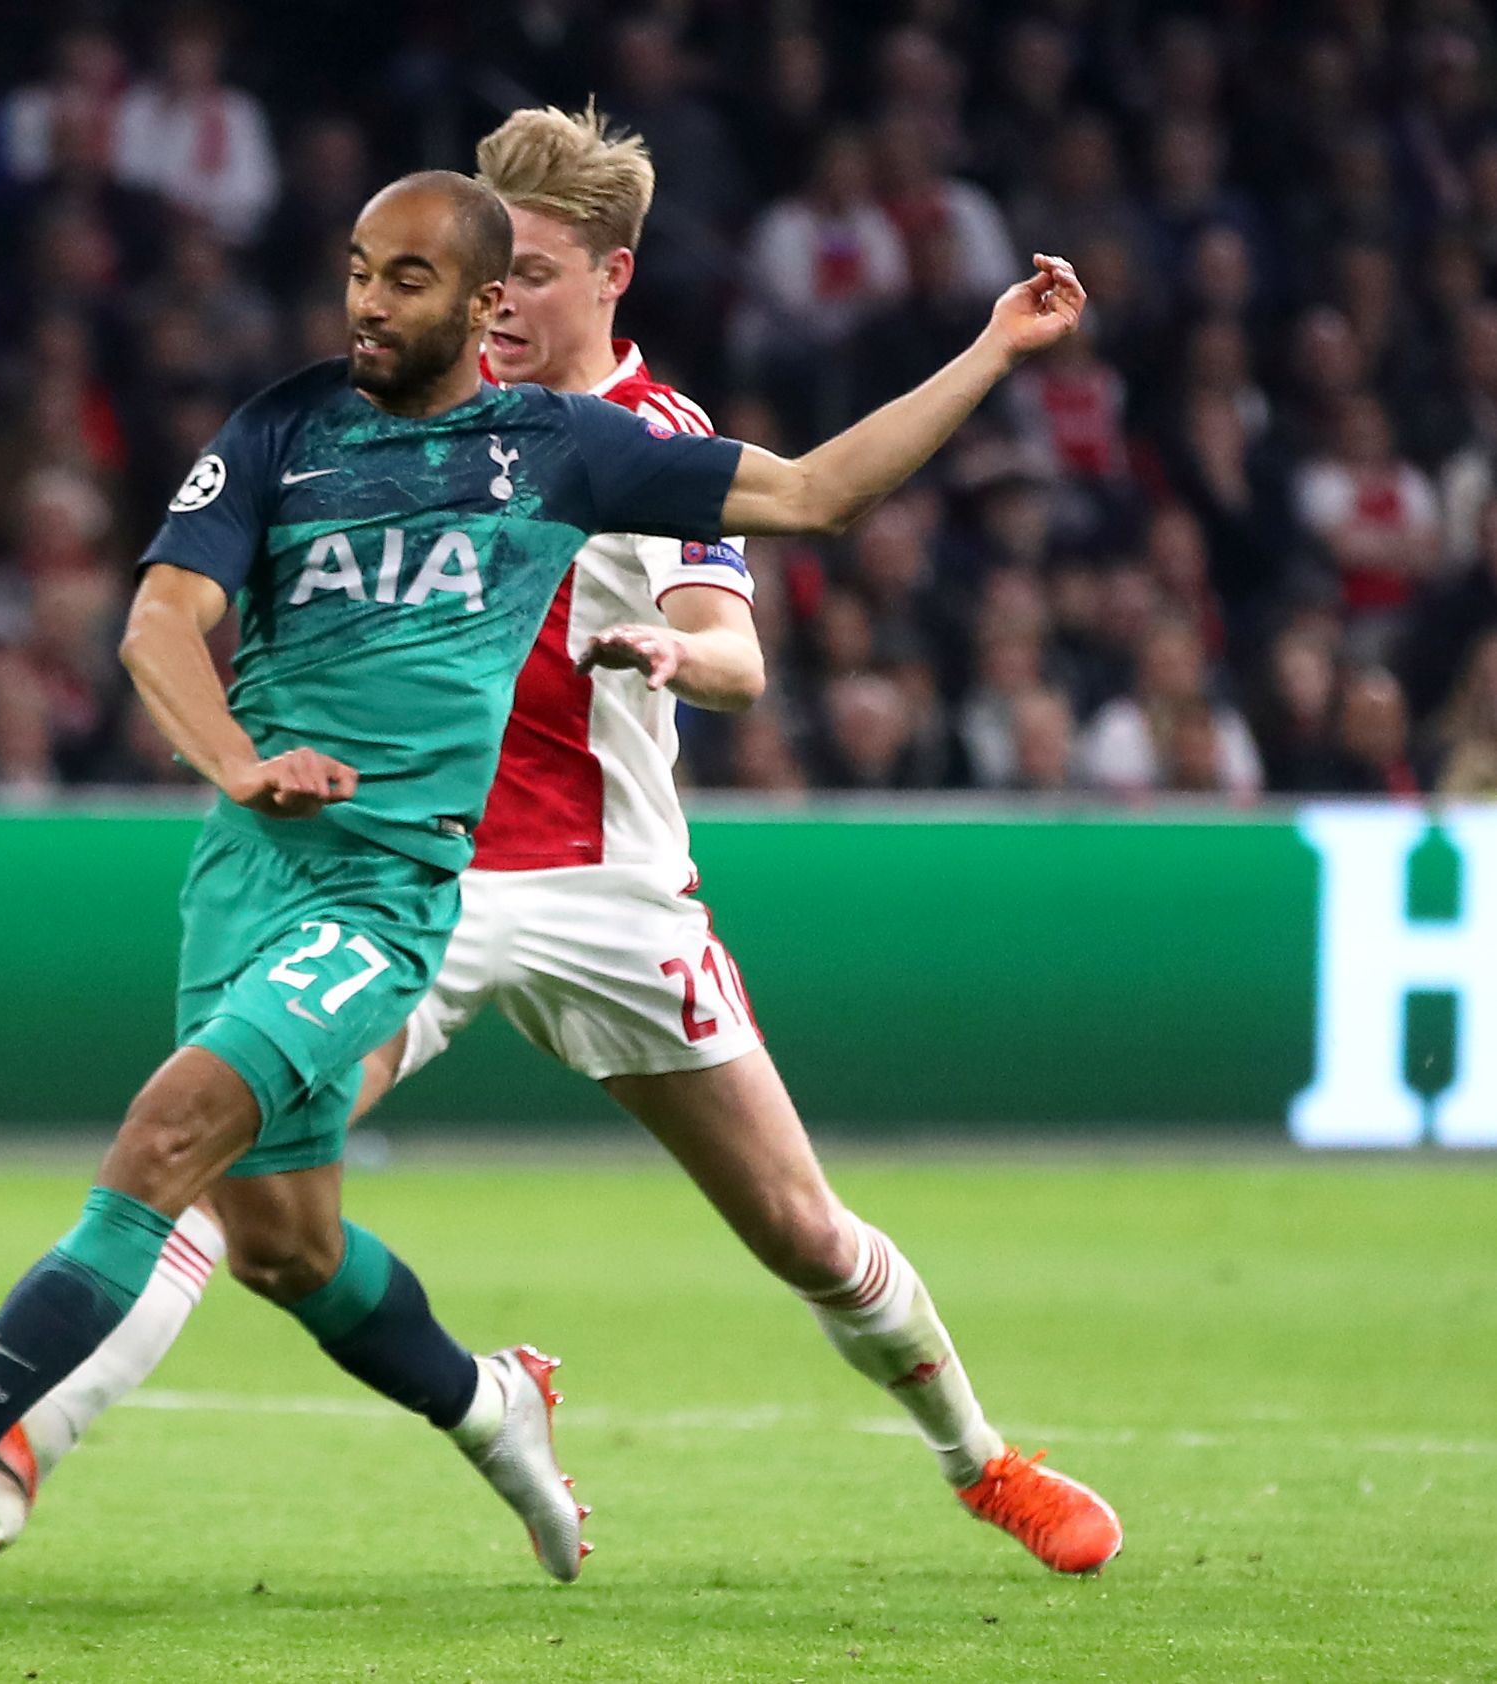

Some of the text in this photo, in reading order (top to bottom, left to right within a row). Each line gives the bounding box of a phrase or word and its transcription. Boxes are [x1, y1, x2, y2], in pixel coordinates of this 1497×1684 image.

[289, 528, 486, 611] AIA
[267, 922, 391, 1016] 27
[659, 945, 742, 1043] 21
